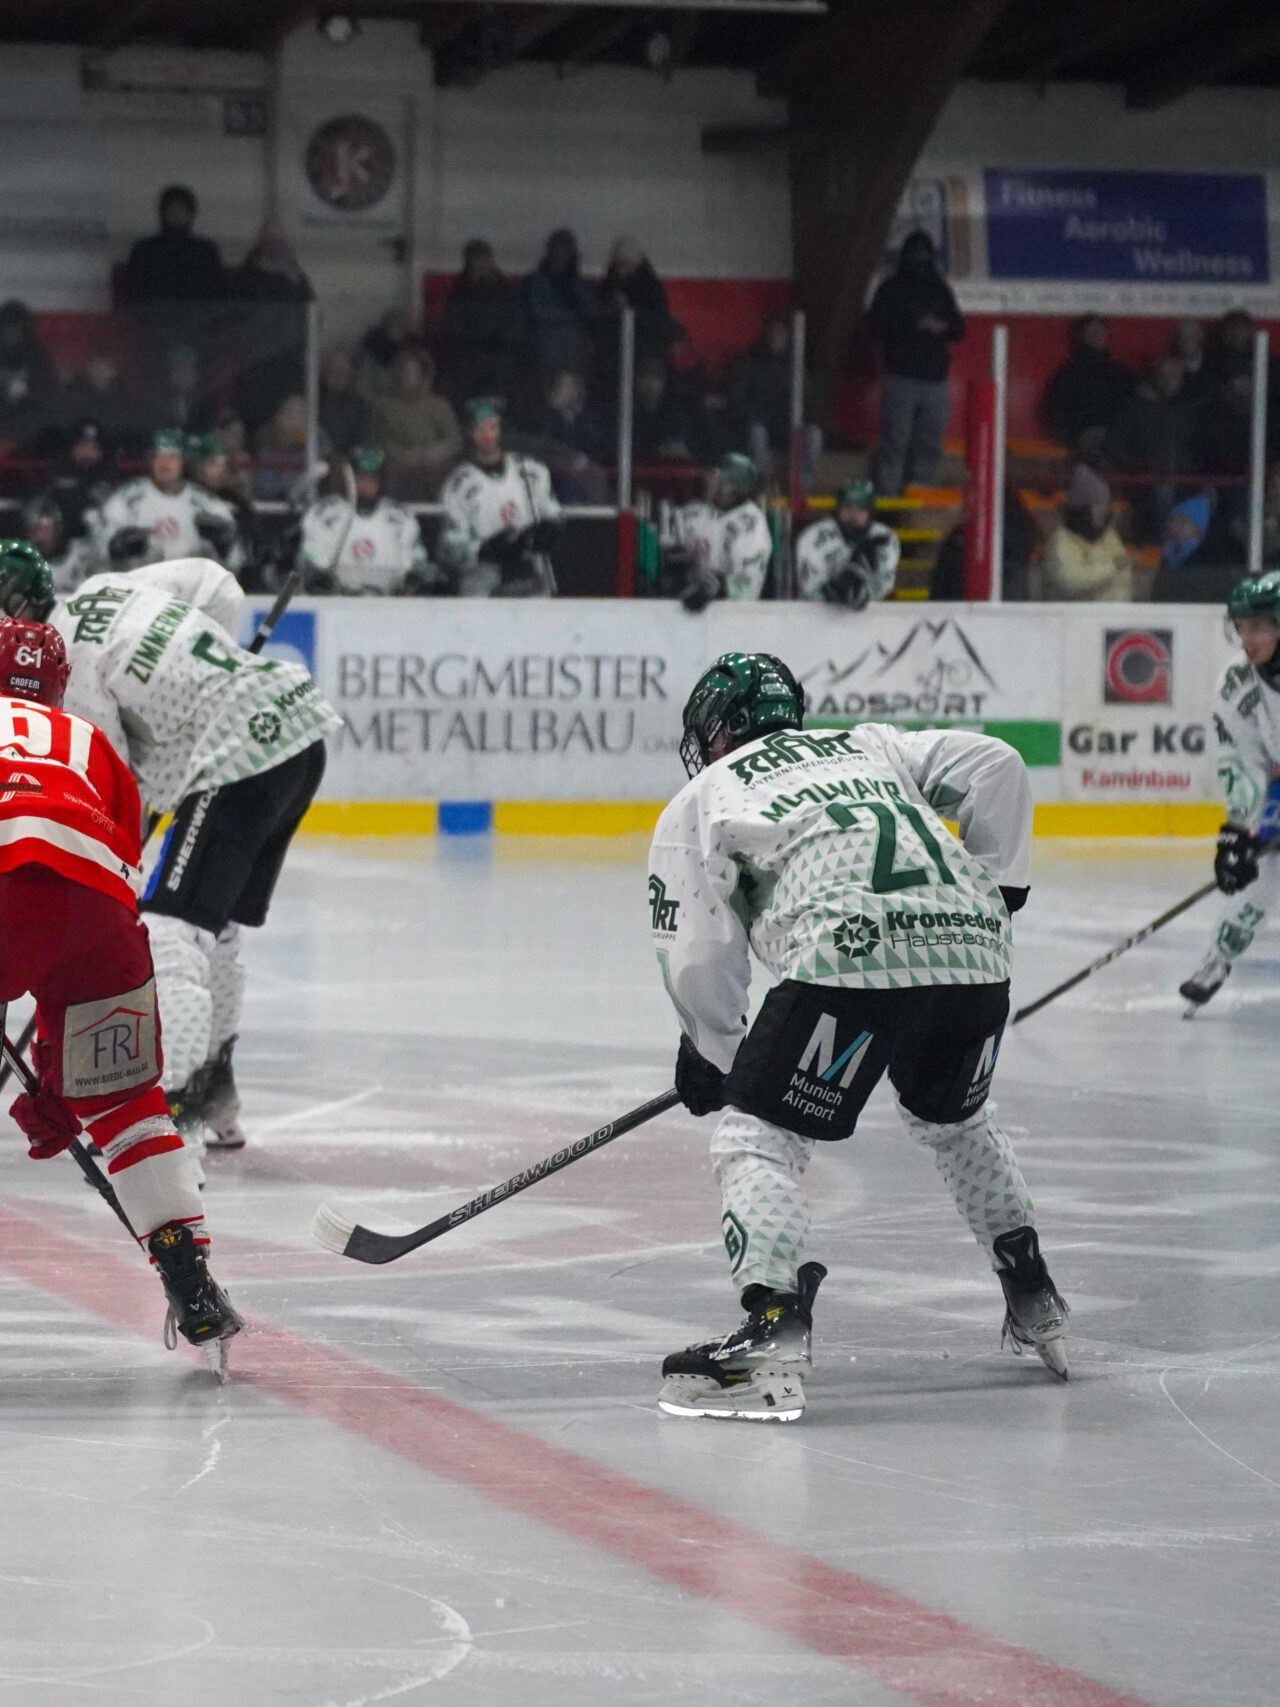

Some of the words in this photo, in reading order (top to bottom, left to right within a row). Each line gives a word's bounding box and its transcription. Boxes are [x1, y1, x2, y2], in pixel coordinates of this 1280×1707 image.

[1000, 180, 1098, 209] Fitness
[1064, 213, 1167, 241] Aerobic
[1131, 247, 1254, 276] Wellness
[15, 646, 43, 669] 61
[10, 676, 41, 690] CADFEM
[337, 653, 668, 700] BERGMEISTER
[336, 709, 636, 755] METALLBAU
[1068, 723, 1138, 756] Gar
[1153, 722, 1206, 756] KG
[1081, 767, 1192, 789] Kaminbau
[825, 801, 957, 895] 21
[885, 911, 1003, 933] Kronseder
[89, 1023, 133, 1069] FR
[782, 1089, 836, 1122] Airport
[789, 1073, 844, 1107] Munich
[449, 1122, 614, 1226] SHERWOOD
